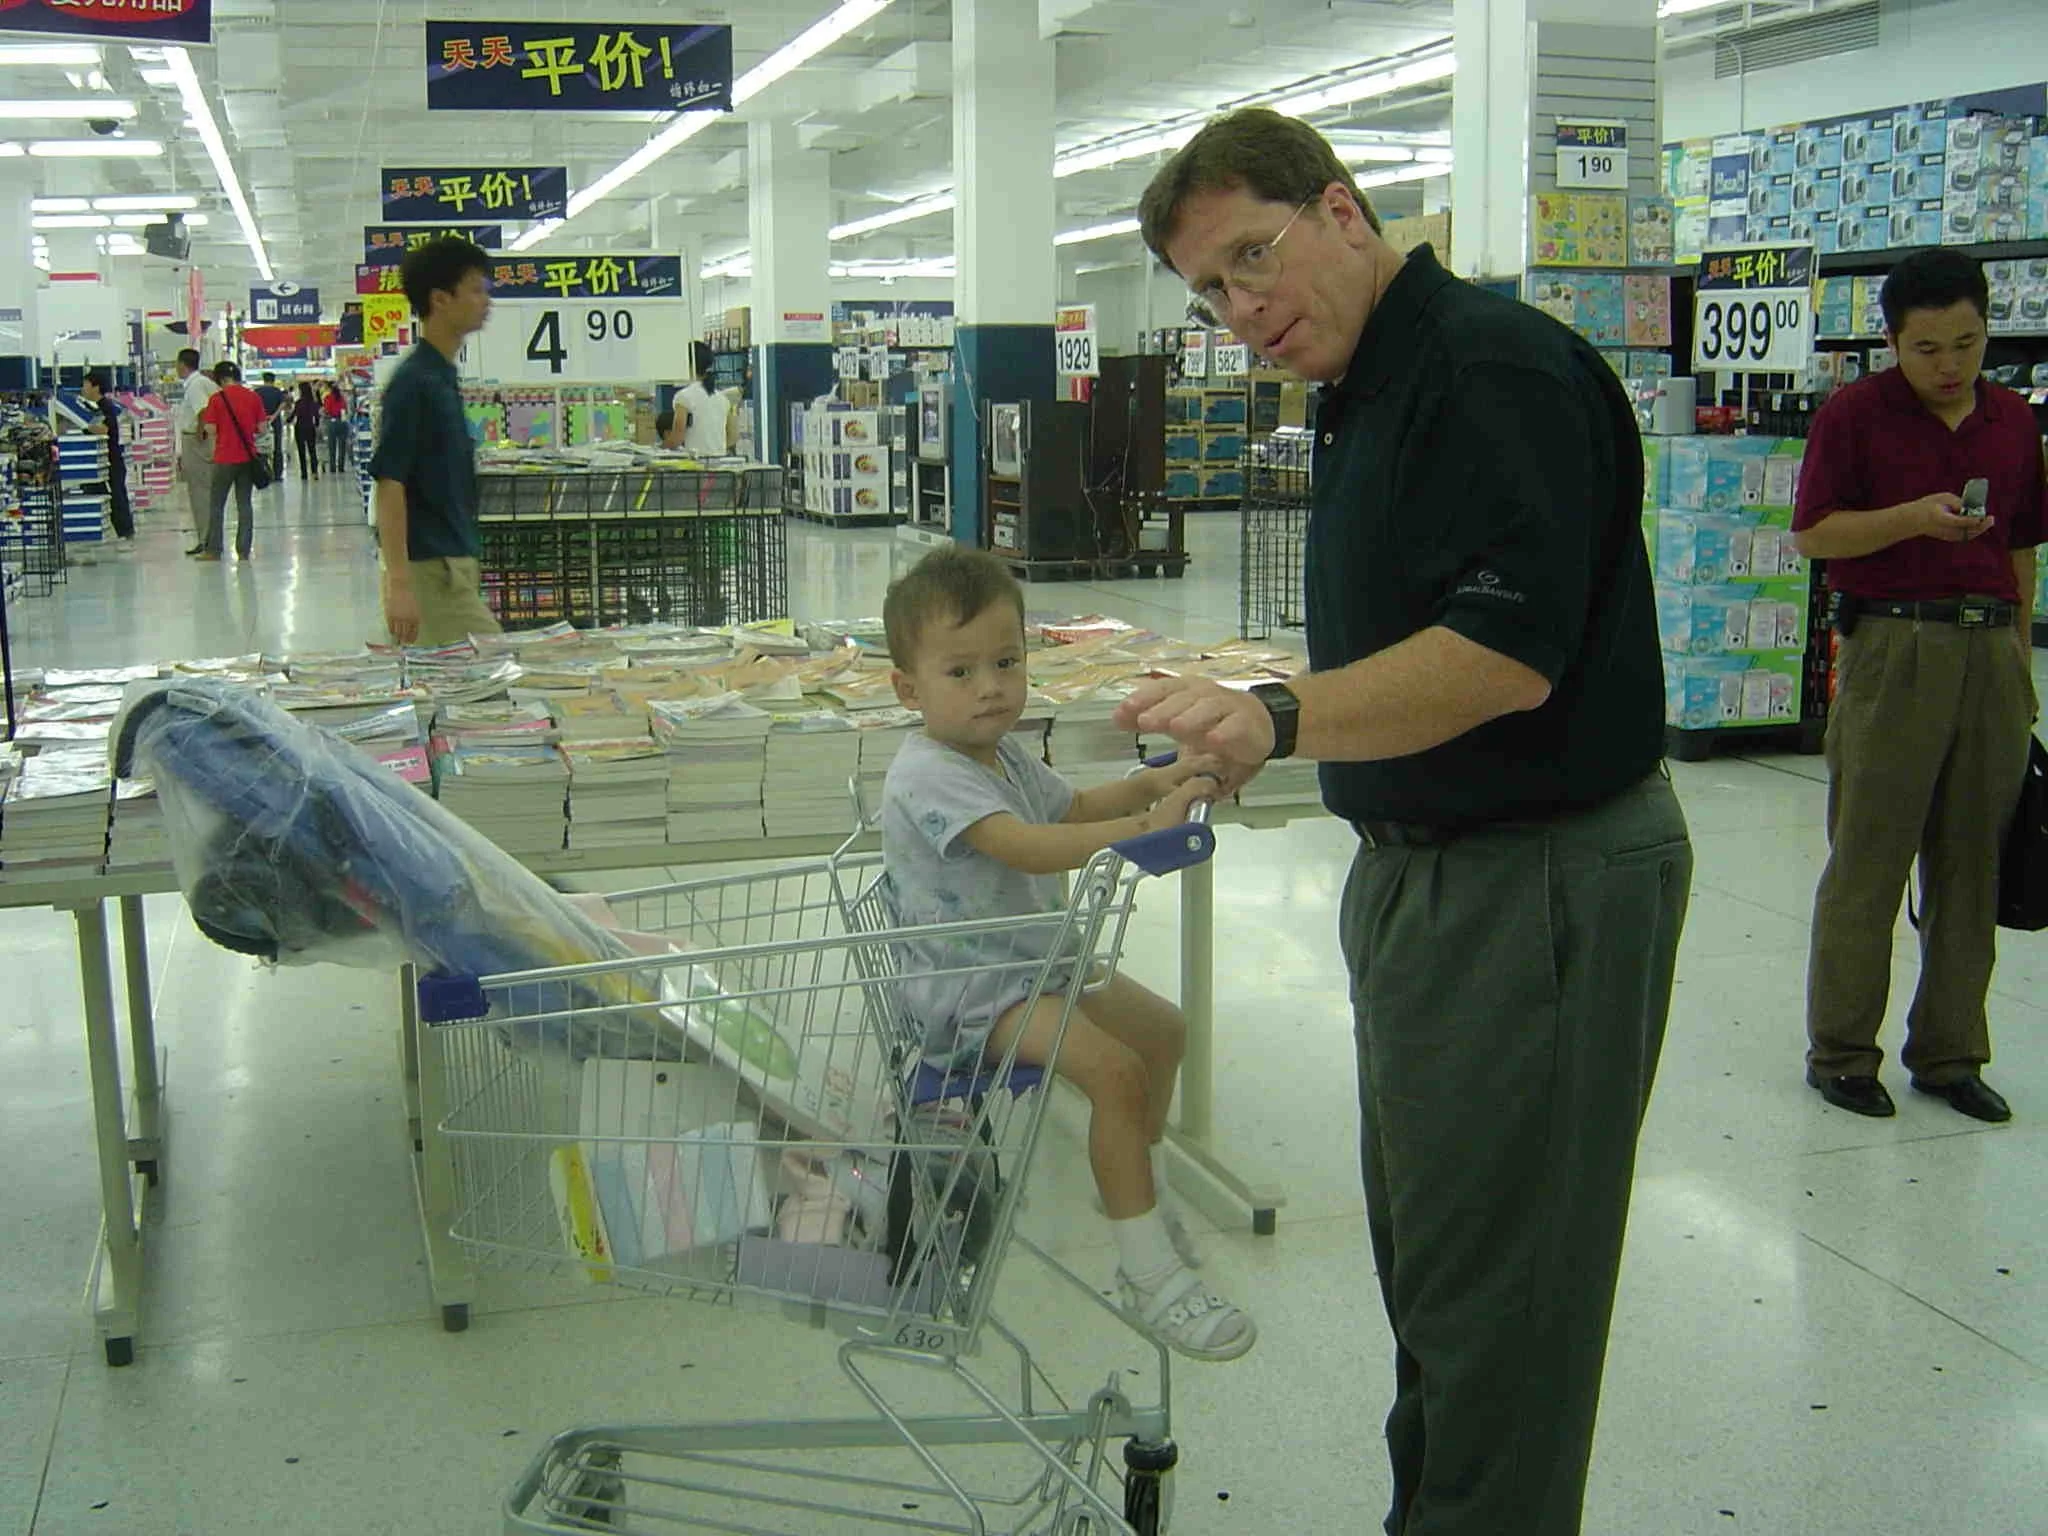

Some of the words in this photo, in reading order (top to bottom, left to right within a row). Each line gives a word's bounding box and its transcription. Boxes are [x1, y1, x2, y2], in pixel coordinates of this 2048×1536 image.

[441, 31, 674, 96] 天天平价!
[1578, 154, 1586, 178] 1
[1591, 156, 1612, 173] 90
[526, 310, 568, 374] 4
[586, 309, 634, 341] 90
[1702, 301, 1772, 361] 399
[1775, 299, 1799, 328] 00
[1058, 337, 1091, 371] 1929
[1218, 350, 1237, 372] 582
[894, 1322, 945, 1349] 630
